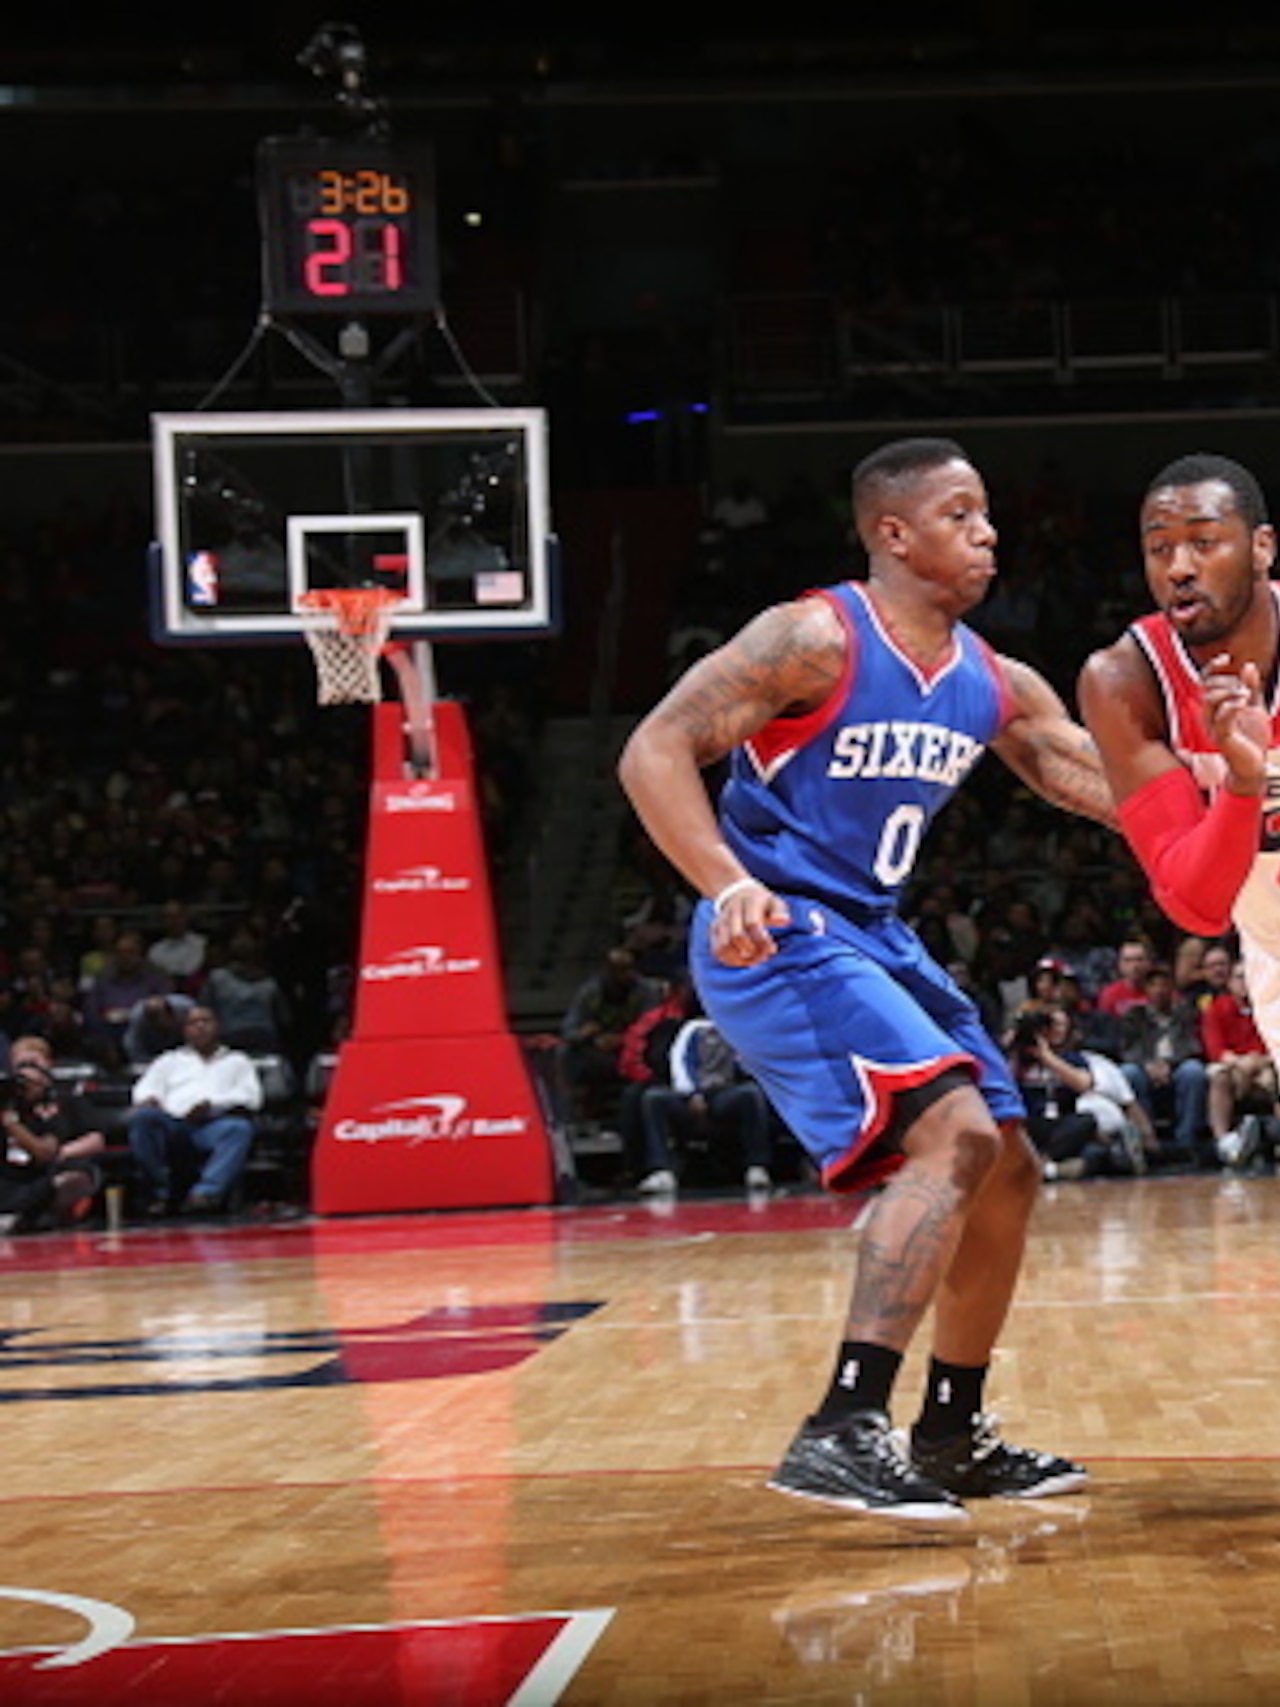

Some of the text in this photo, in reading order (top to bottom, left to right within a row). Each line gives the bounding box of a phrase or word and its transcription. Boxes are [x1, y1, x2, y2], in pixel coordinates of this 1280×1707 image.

[318, 169, 409, 214] 3:26
[305, 219, 402, 295] 21
[873, 804, 925, 886] 0
[333, 1115, 430, 1143] Capital
